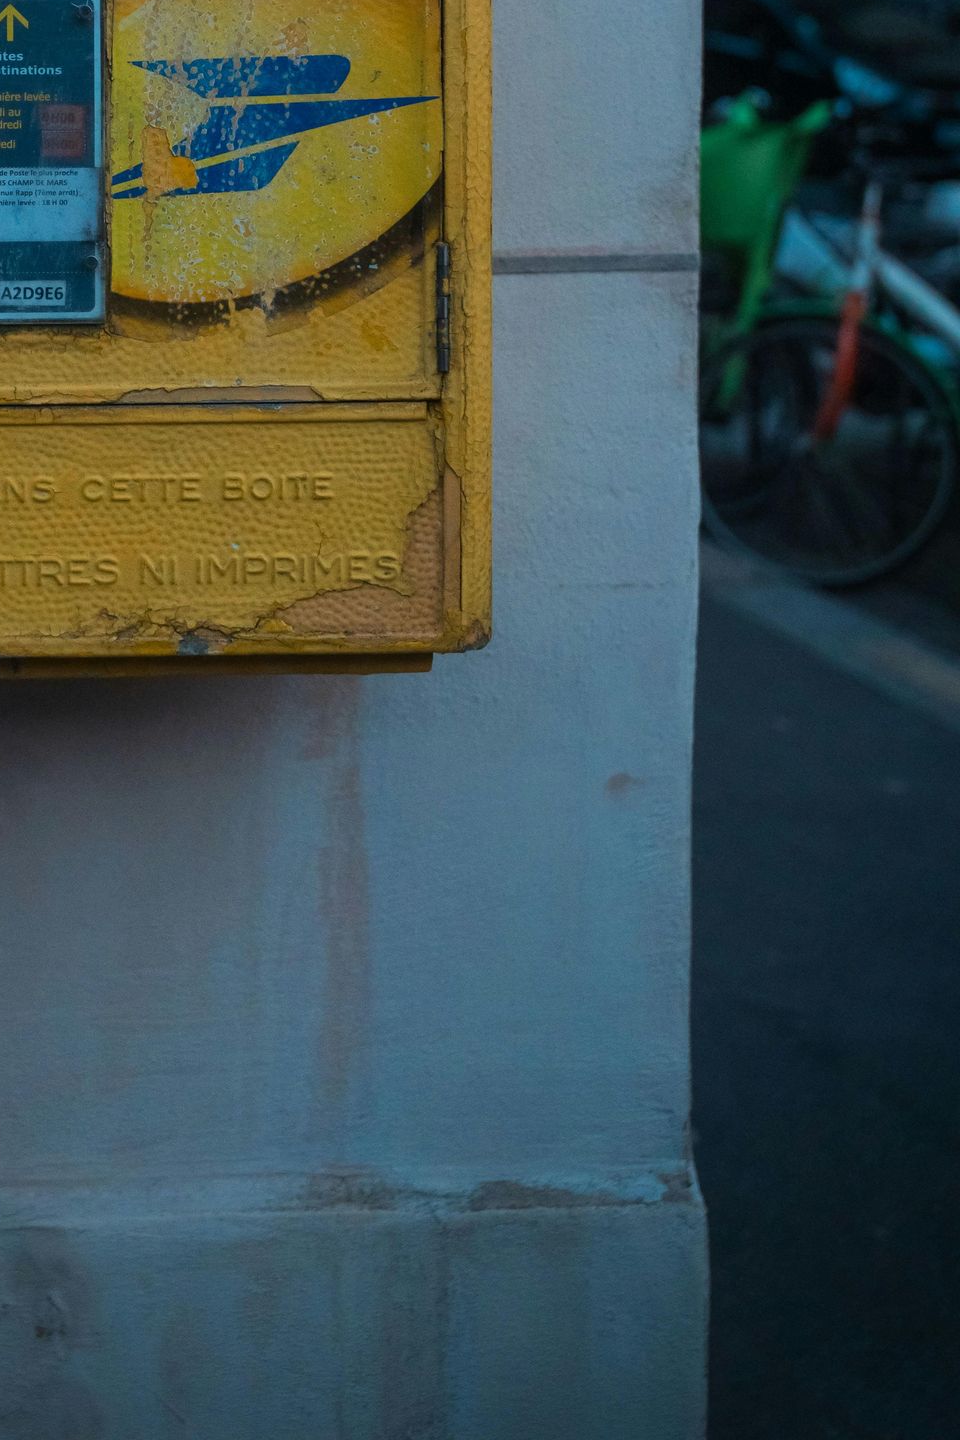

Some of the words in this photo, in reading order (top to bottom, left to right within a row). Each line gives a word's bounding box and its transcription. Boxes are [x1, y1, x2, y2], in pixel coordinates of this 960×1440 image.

[24, 91, 51, 101] levée
[7, 108, 21, 117] au
[9, 169, 28, 177] Poste
[54, 169, 79, 178] proche
[15, 189, 33, 198] Rapp
[0, 286, 64, 300] A2D9E6
[80, 471, 202, 502] CETTE
[222, 470, 335, 502] BOITE
[139, 552, 177, 586] NI
[196, 549, 403, 585] IMPRIMES
